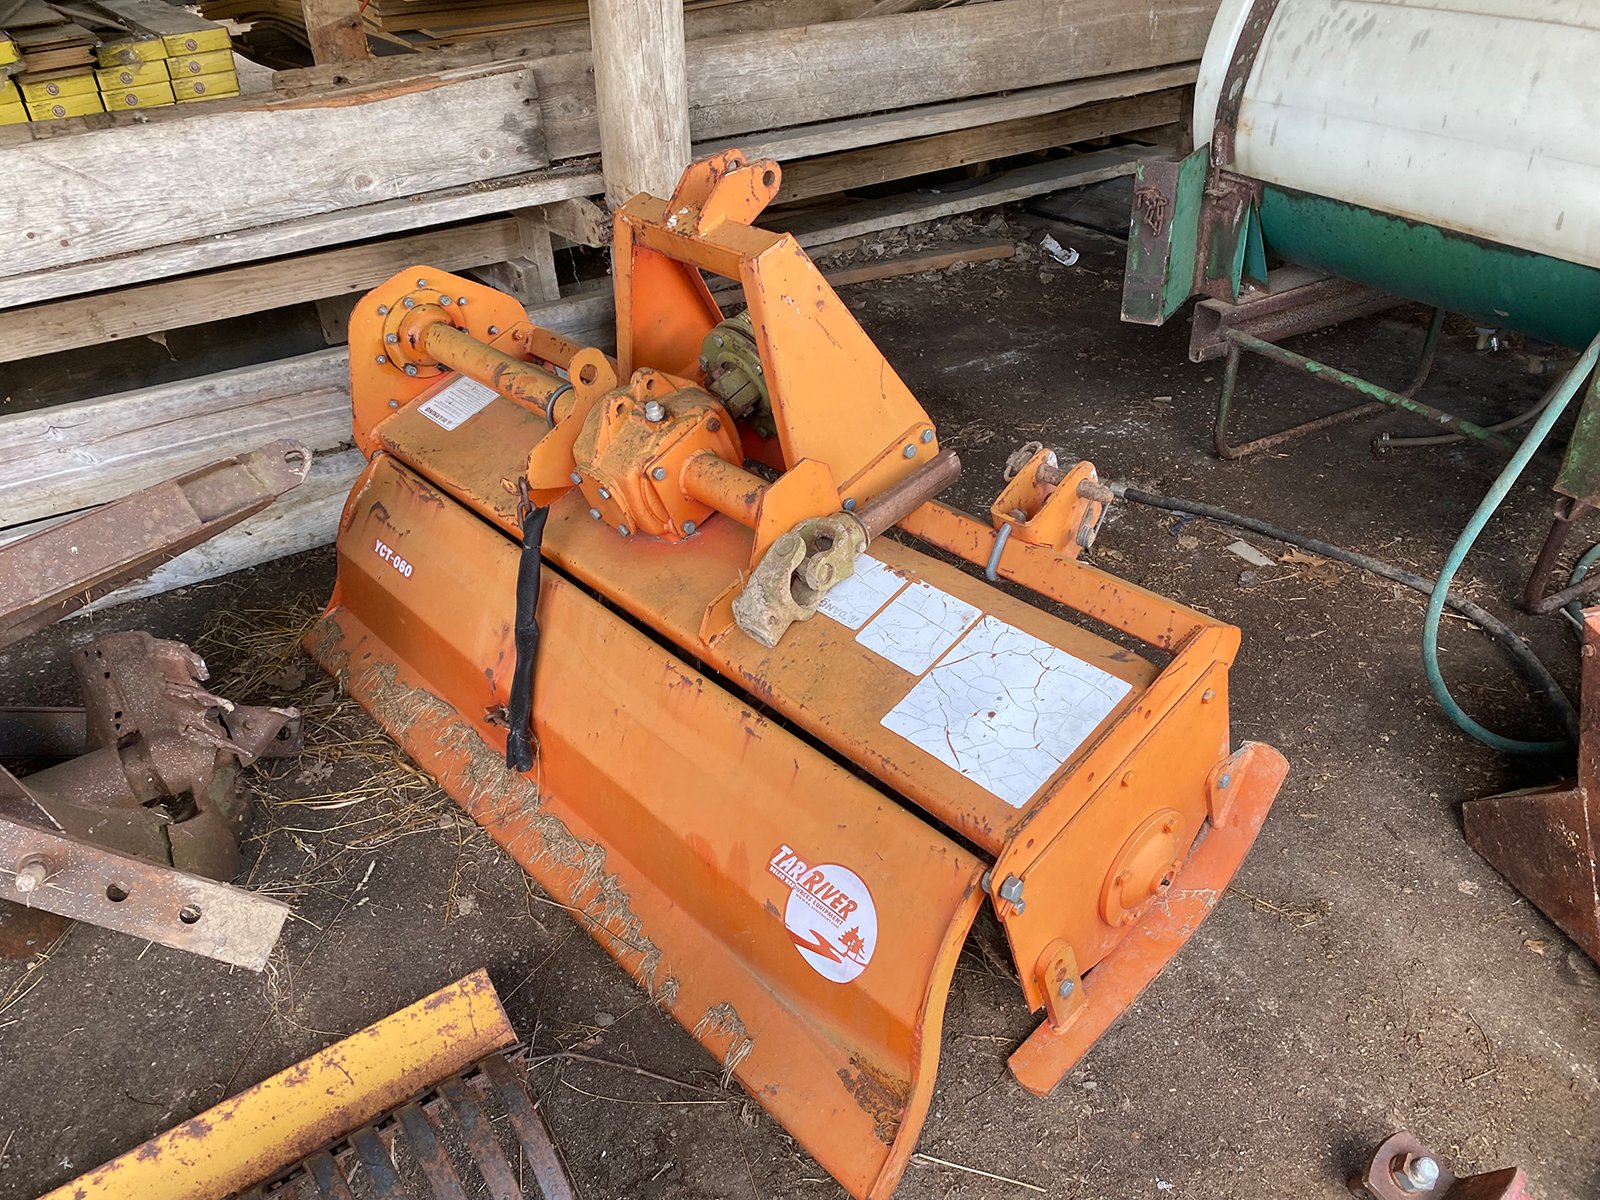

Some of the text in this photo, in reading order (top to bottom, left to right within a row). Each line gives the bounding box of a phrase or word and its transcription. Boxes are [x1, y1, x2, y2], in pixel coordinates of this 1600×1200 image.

[374, 539, 413, 577] YCT-060
[818, 600, 847, 618] DANG
[771, 845, 808, 880] TAR
[803, 870, 858, 919] RIVER
[812, 900, 844, 925] EQUIPMENT
